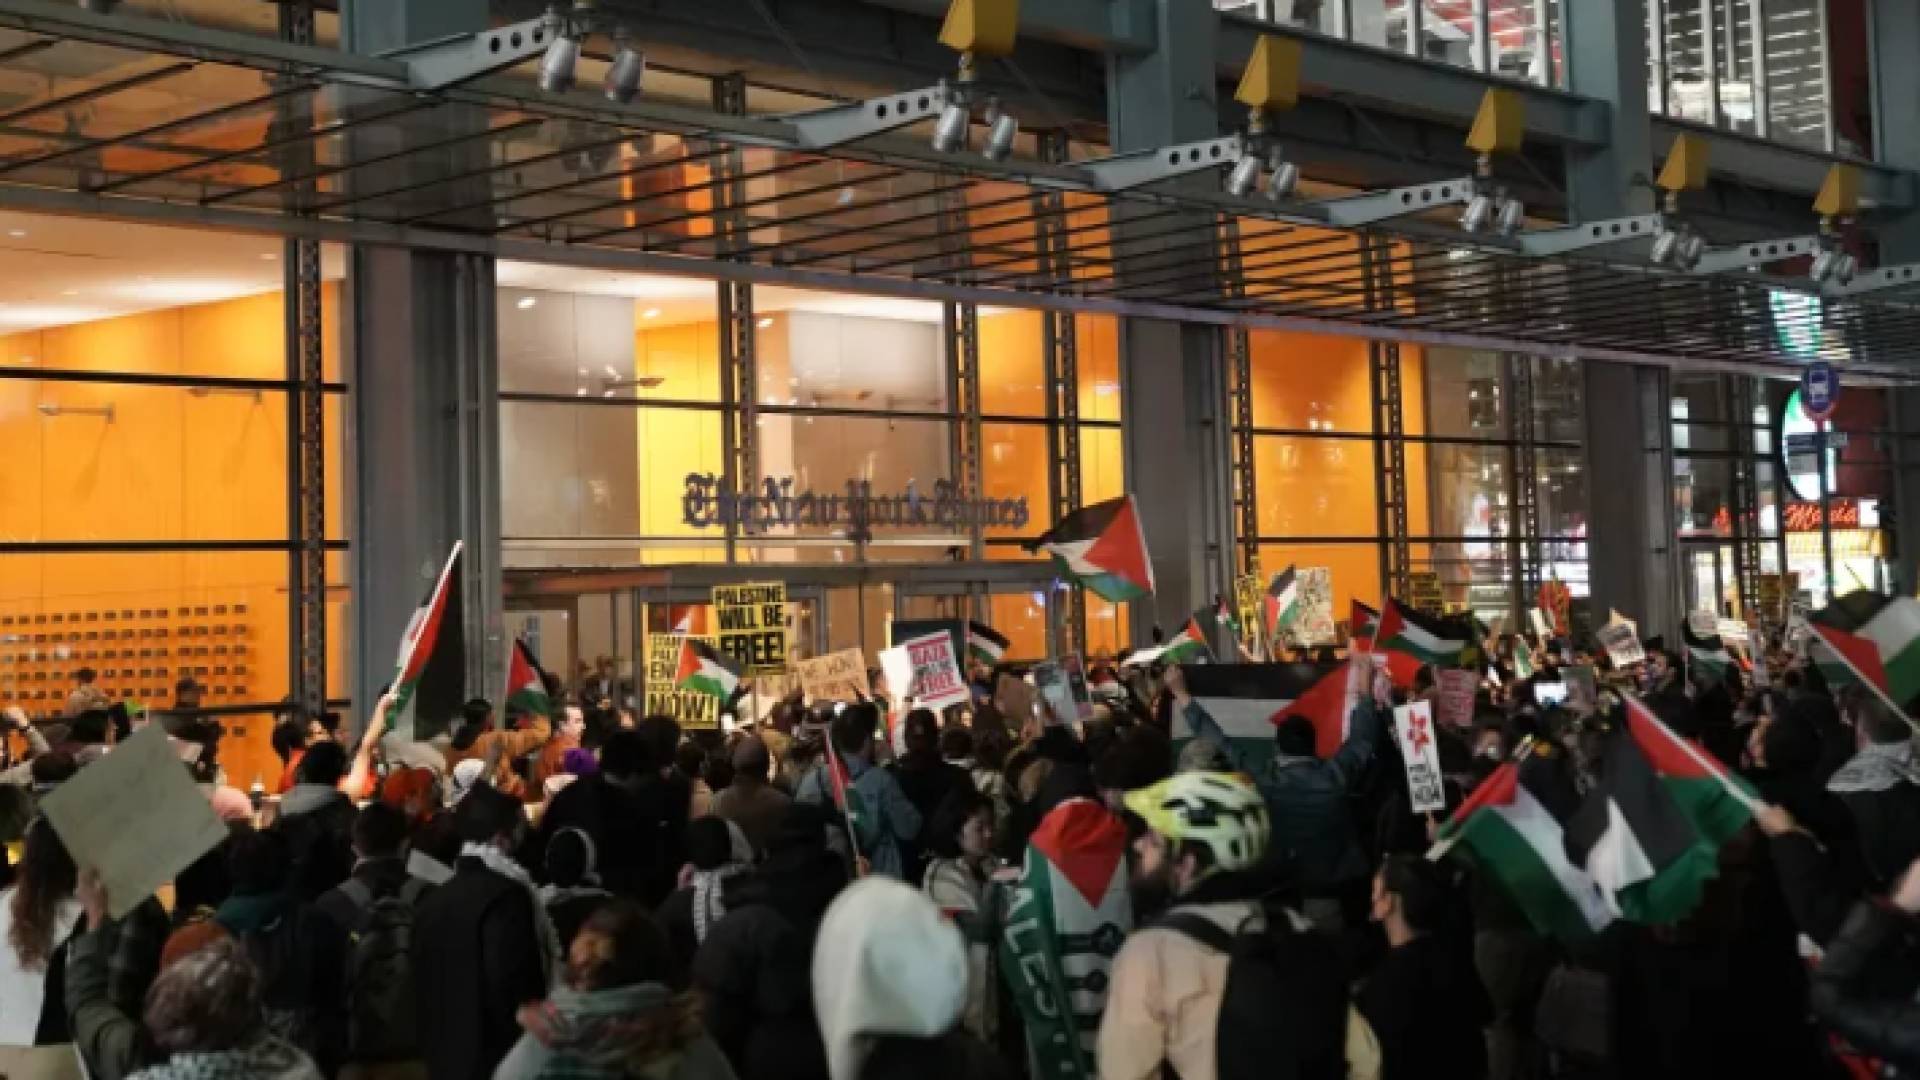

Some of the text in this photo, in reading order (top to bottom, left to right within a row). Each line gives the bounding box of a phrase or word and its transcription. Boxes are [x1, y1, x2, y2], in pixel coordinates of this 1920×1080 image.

[682, 472, 1030, 543] The New York Times
[718, 603, 784, 630] WILL BE
[720, 631, 784, 665] FREE!
[648, 690, 714, 720] NOW!
